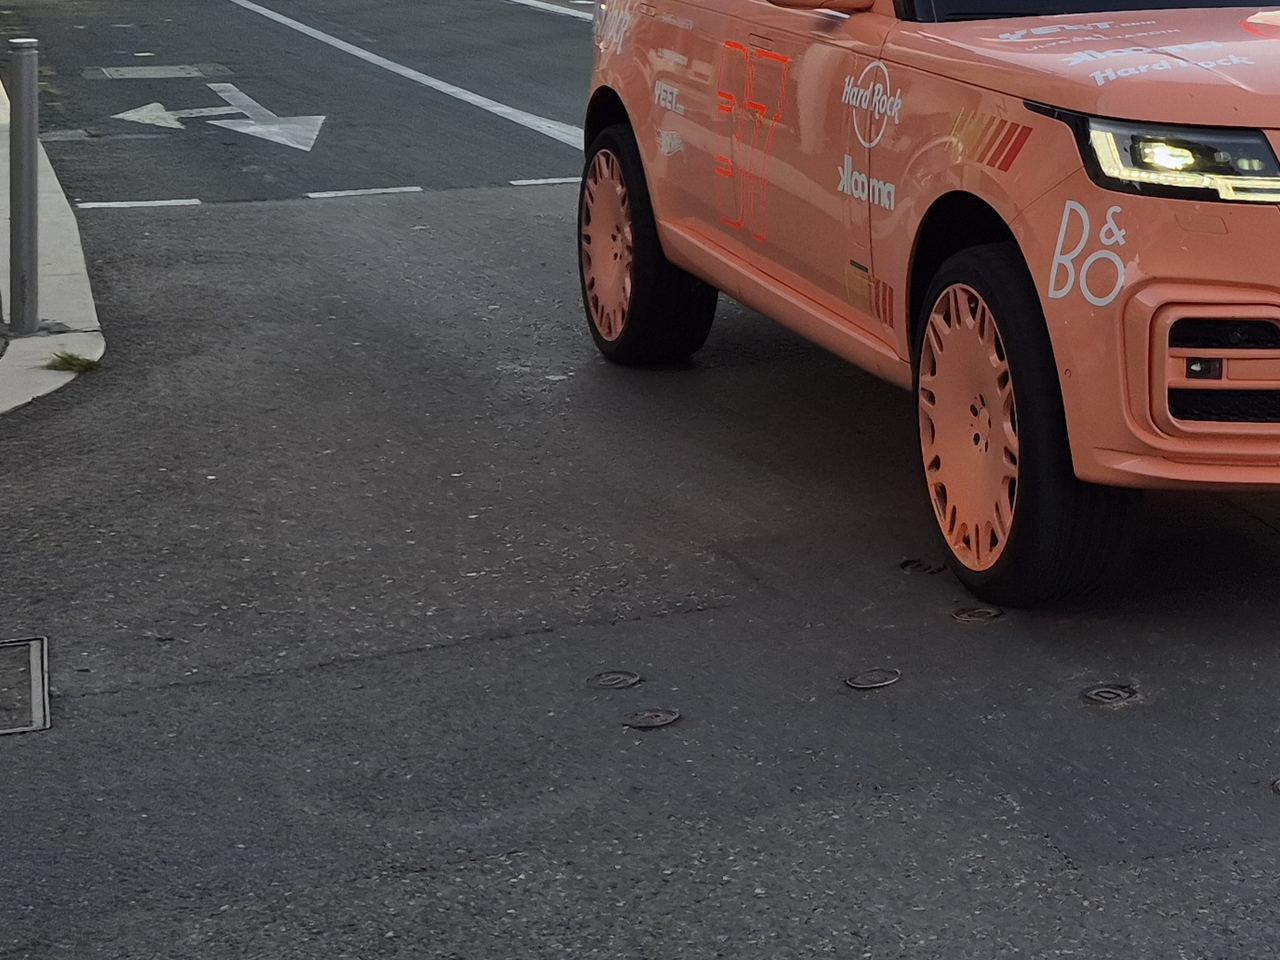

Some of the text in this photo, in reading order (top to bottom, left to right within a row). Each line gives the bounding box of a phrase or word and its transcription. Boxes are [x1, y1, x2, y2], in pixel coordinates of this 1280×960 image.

[1090, 59, 1172, 86] Hard
[841, 75, 902, 124] Hard Rock
